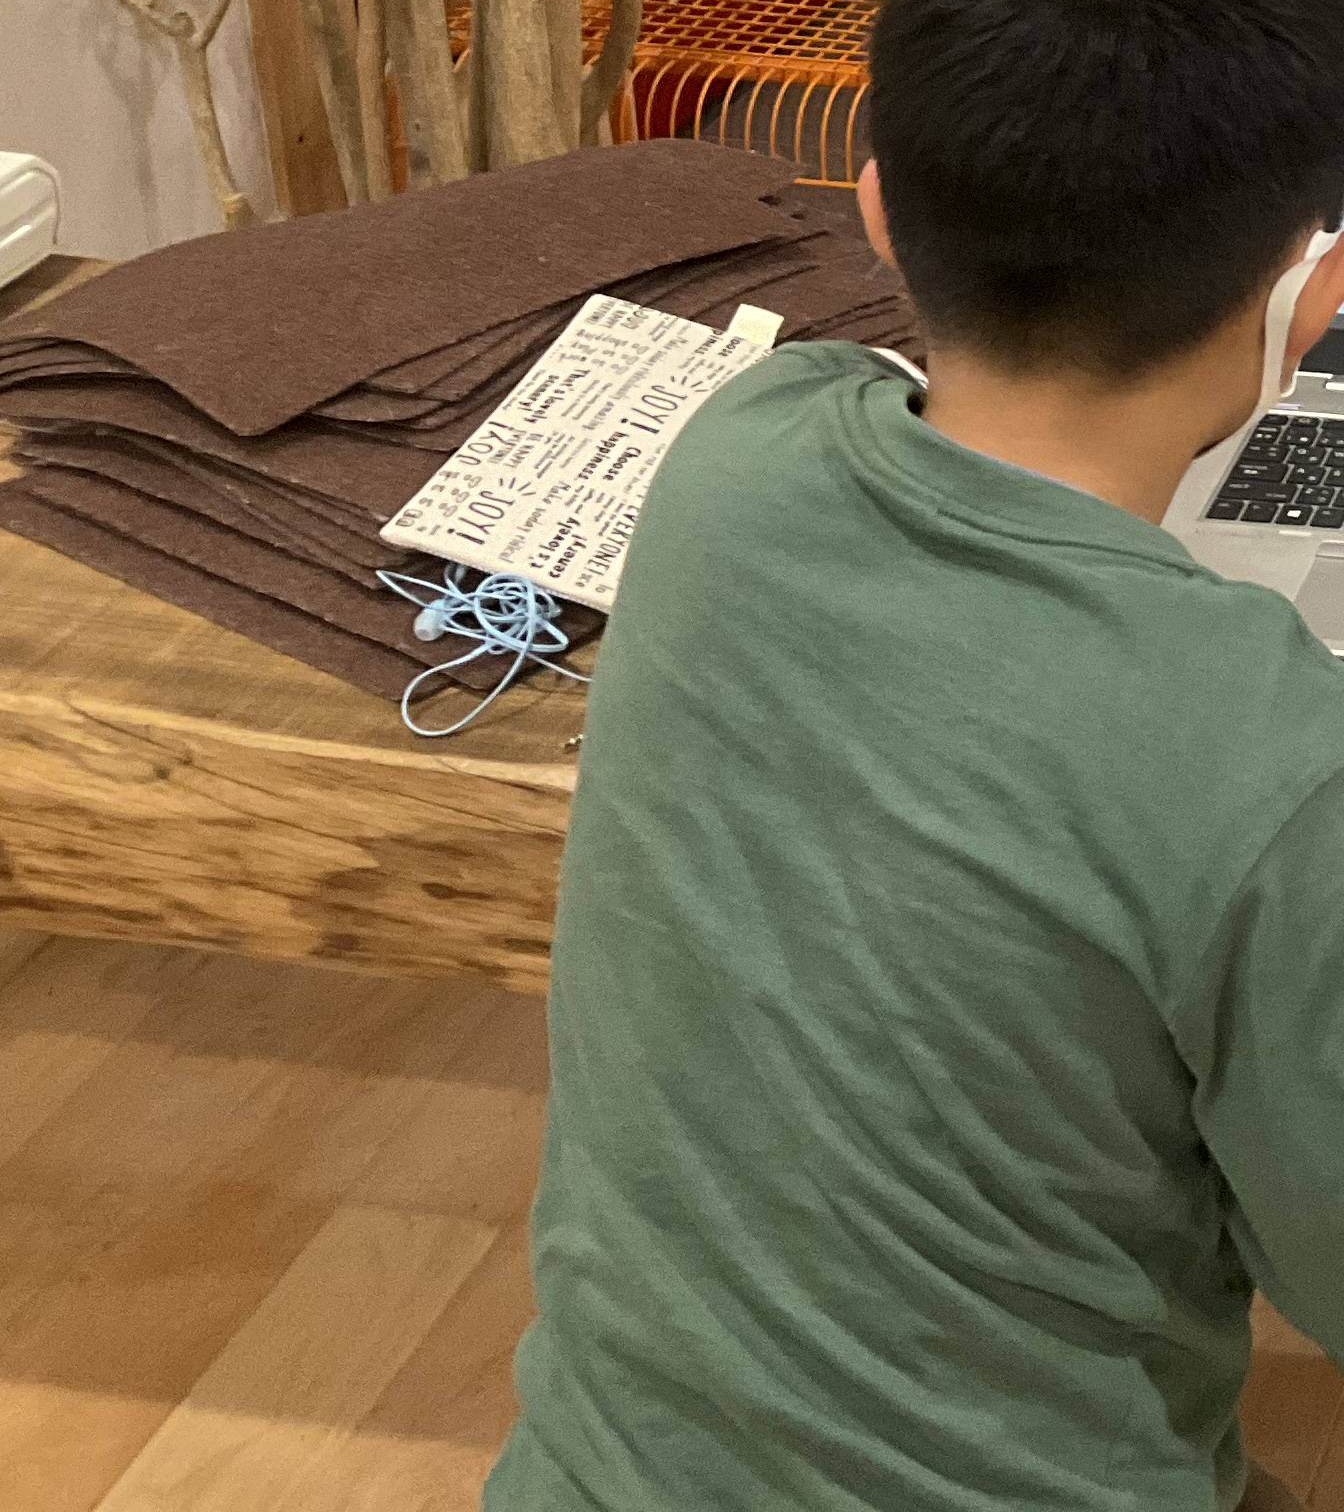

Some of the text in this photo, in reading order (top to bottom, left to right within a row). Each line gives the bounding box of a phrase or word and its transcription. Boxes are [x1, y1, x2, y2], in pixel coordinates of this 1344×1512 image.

[620, 384, 688, 434] JOY!
[603, 447, 641, 480] Choose
[447, 490, 515, 545] JOY!
[539, 517, 581, 551] lovely
